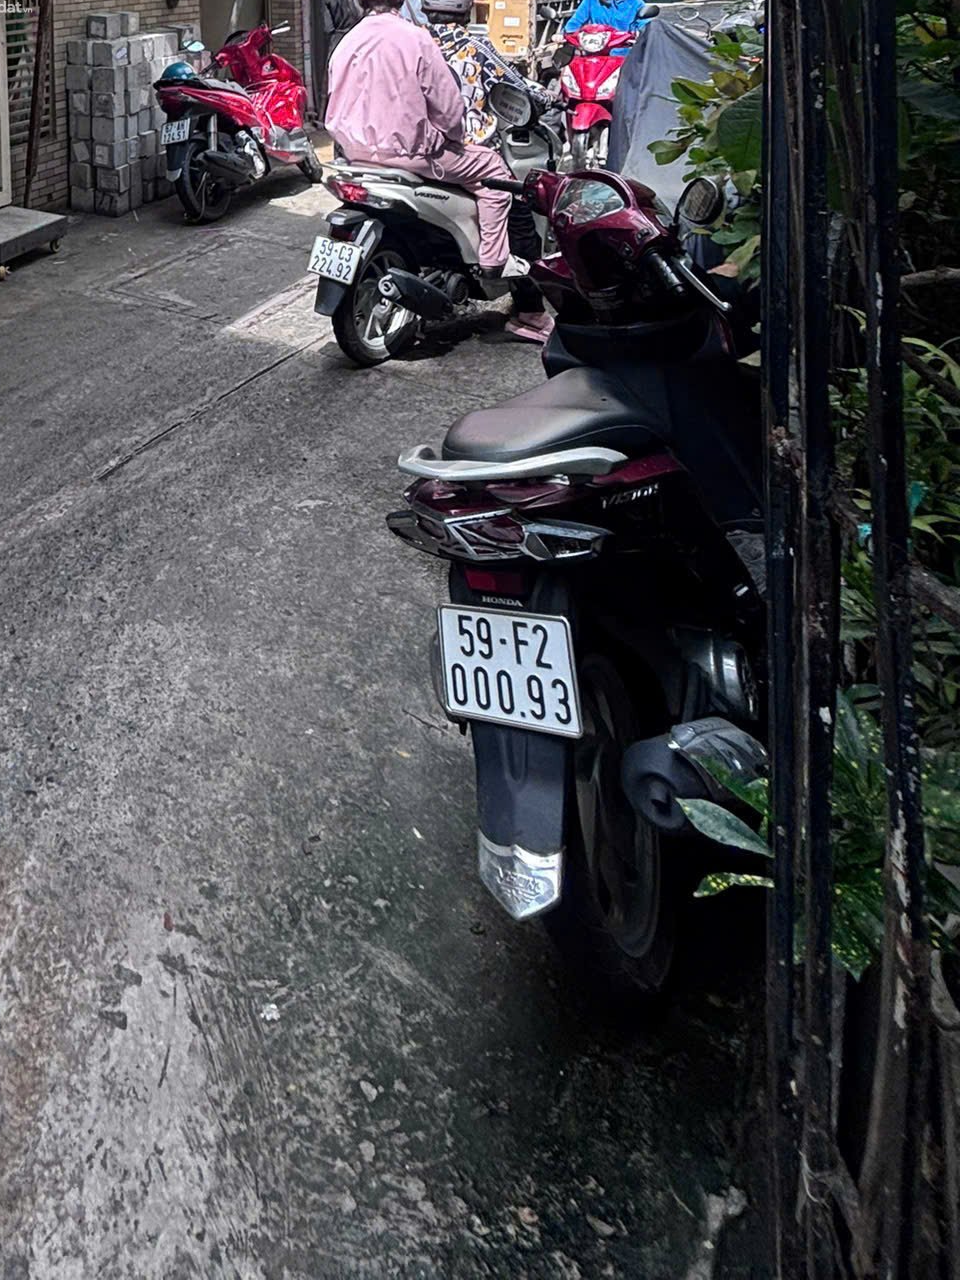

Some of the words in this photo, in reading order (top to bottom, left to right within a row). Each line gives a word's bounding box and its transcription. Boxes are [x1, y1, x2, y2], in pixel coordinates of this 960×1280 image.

[319, 239, 354, 263] 59-C3
[311, 254, 352, 281] 224.92
[481, 595, 524, 608] HONDA
[457, 613, 553, 670] 59-F2
[451, 663, 572, 725] 000.93
